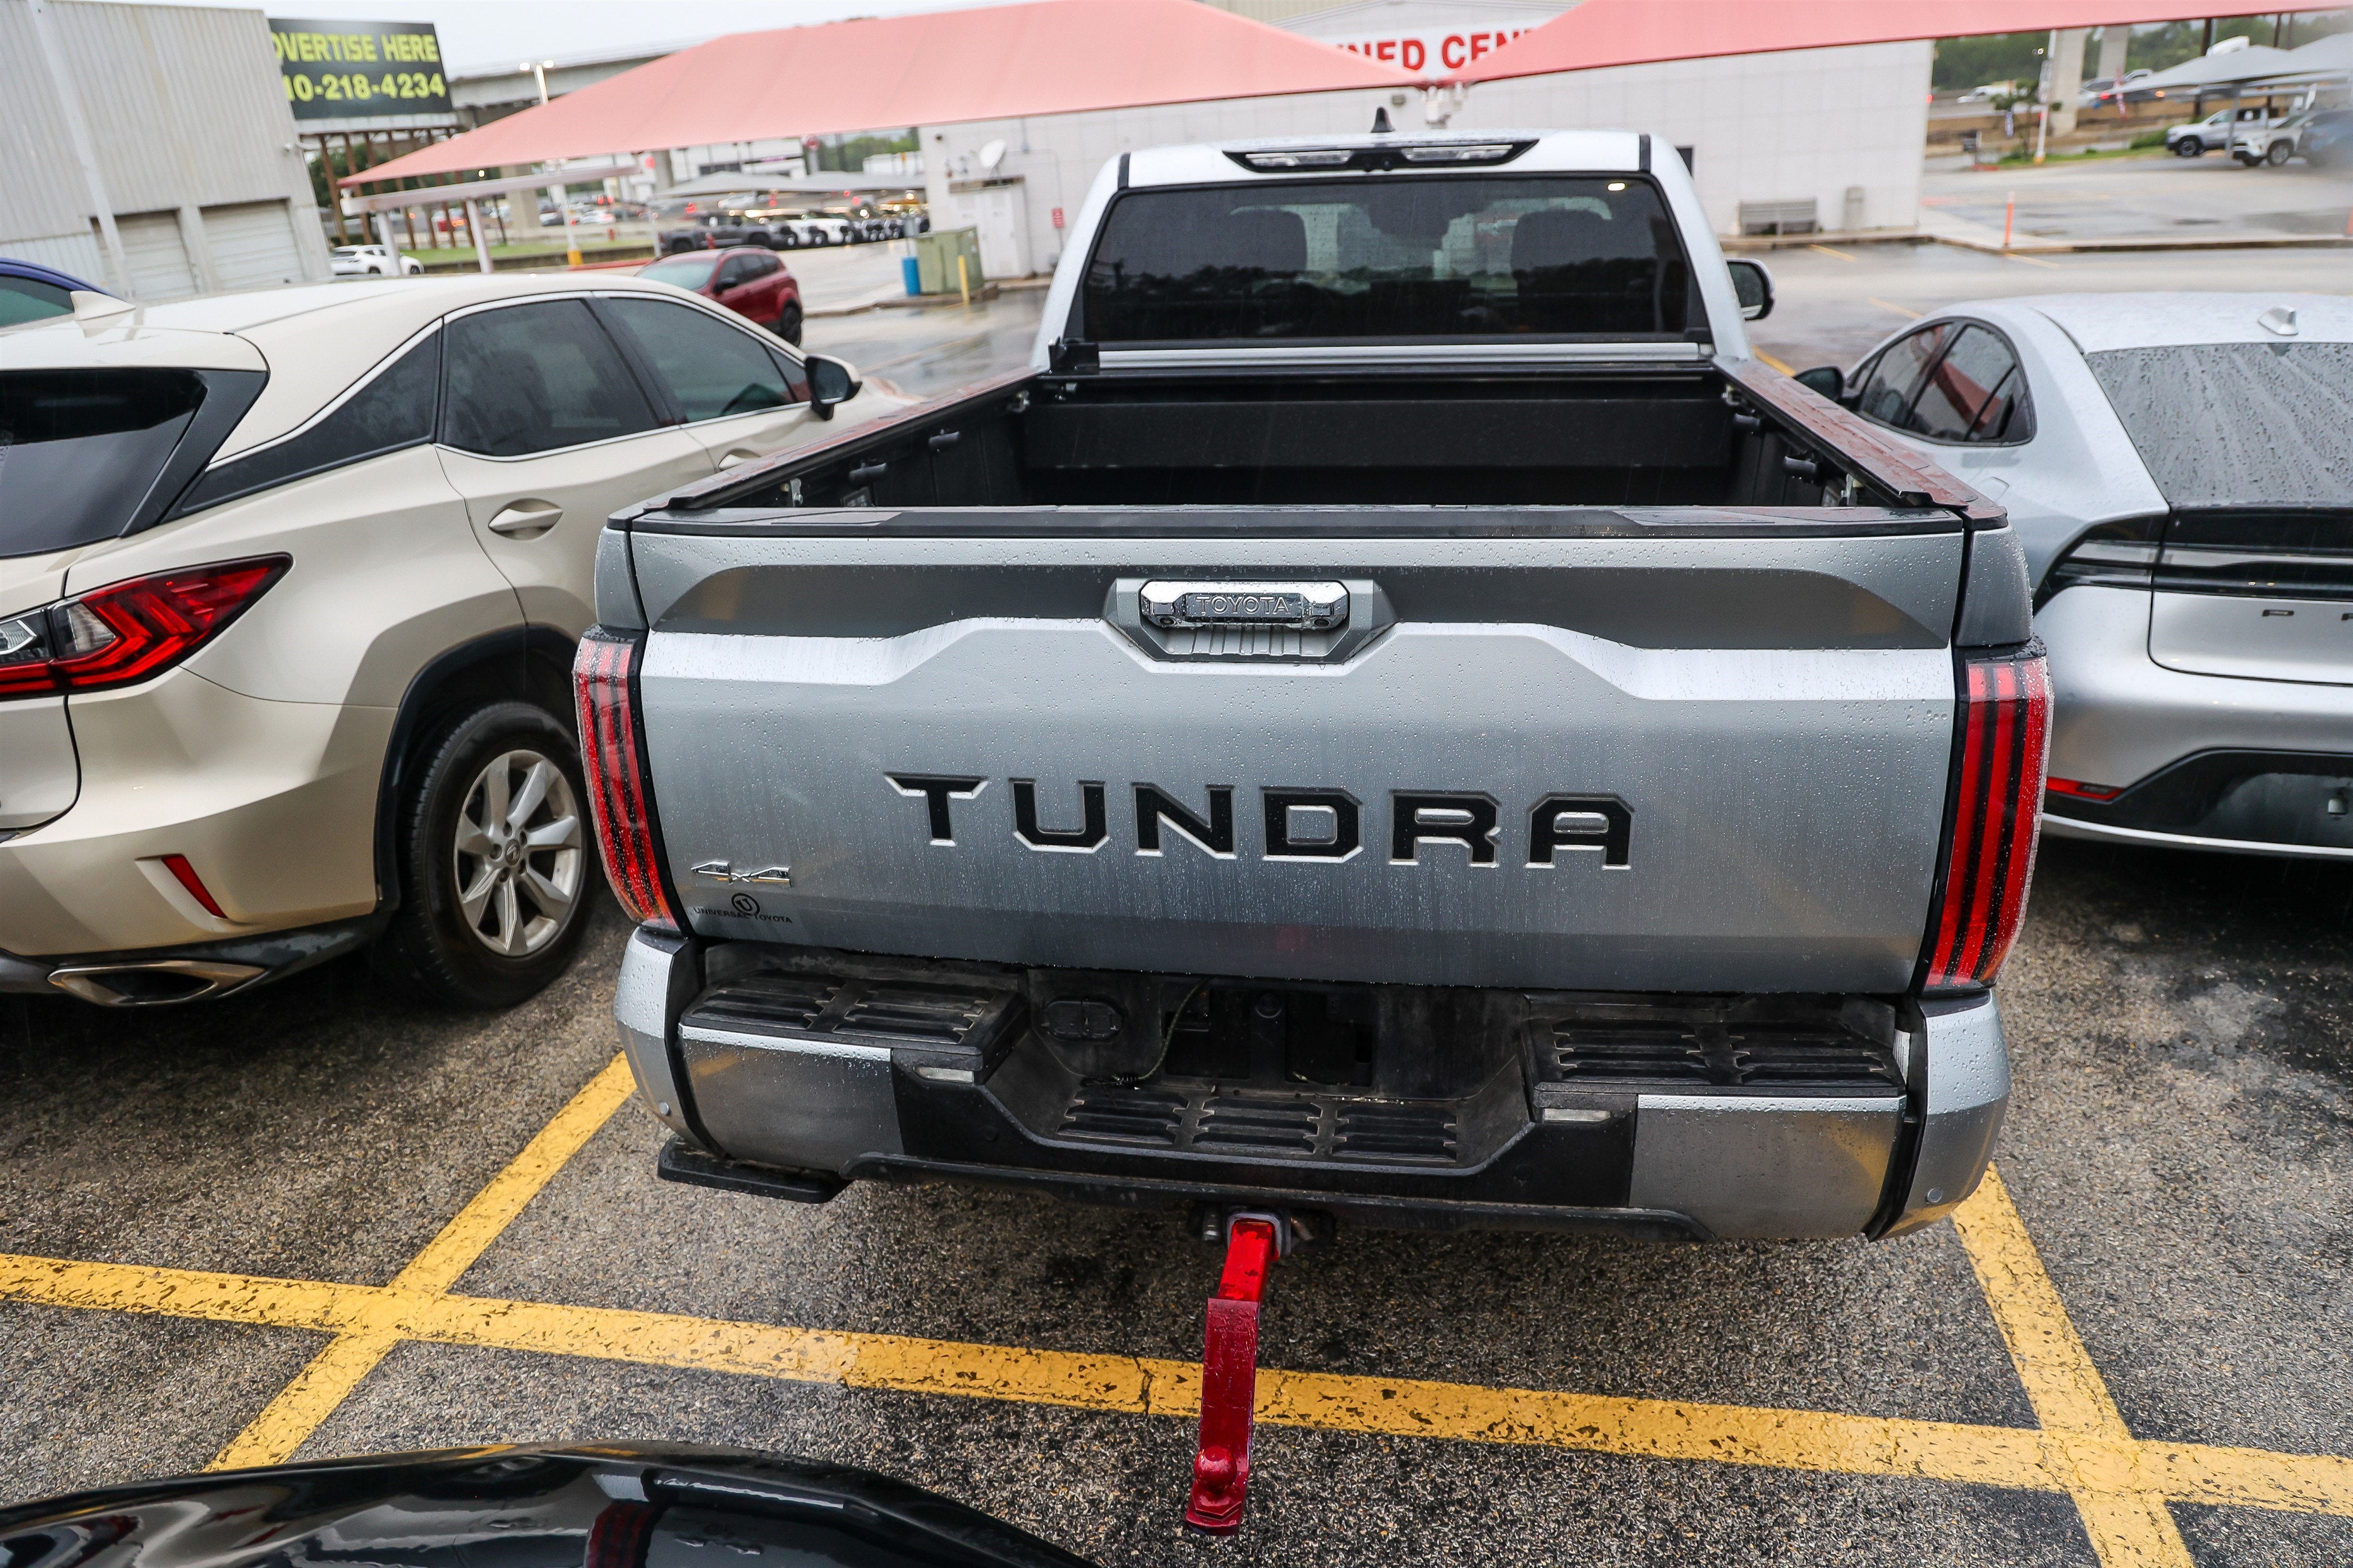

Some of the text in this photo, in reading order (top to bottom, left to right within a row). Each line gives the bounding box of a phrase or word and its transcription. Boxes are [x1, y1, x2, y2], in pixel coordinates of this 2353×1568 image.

[381, 33, 441, 63] HERE
[1195, 596, 1291, 615] TOYOTA
[884, 771, 1635, 871] TUNDRA
[693, 907, 793, 924] UNIVERSAL TOYOTA
